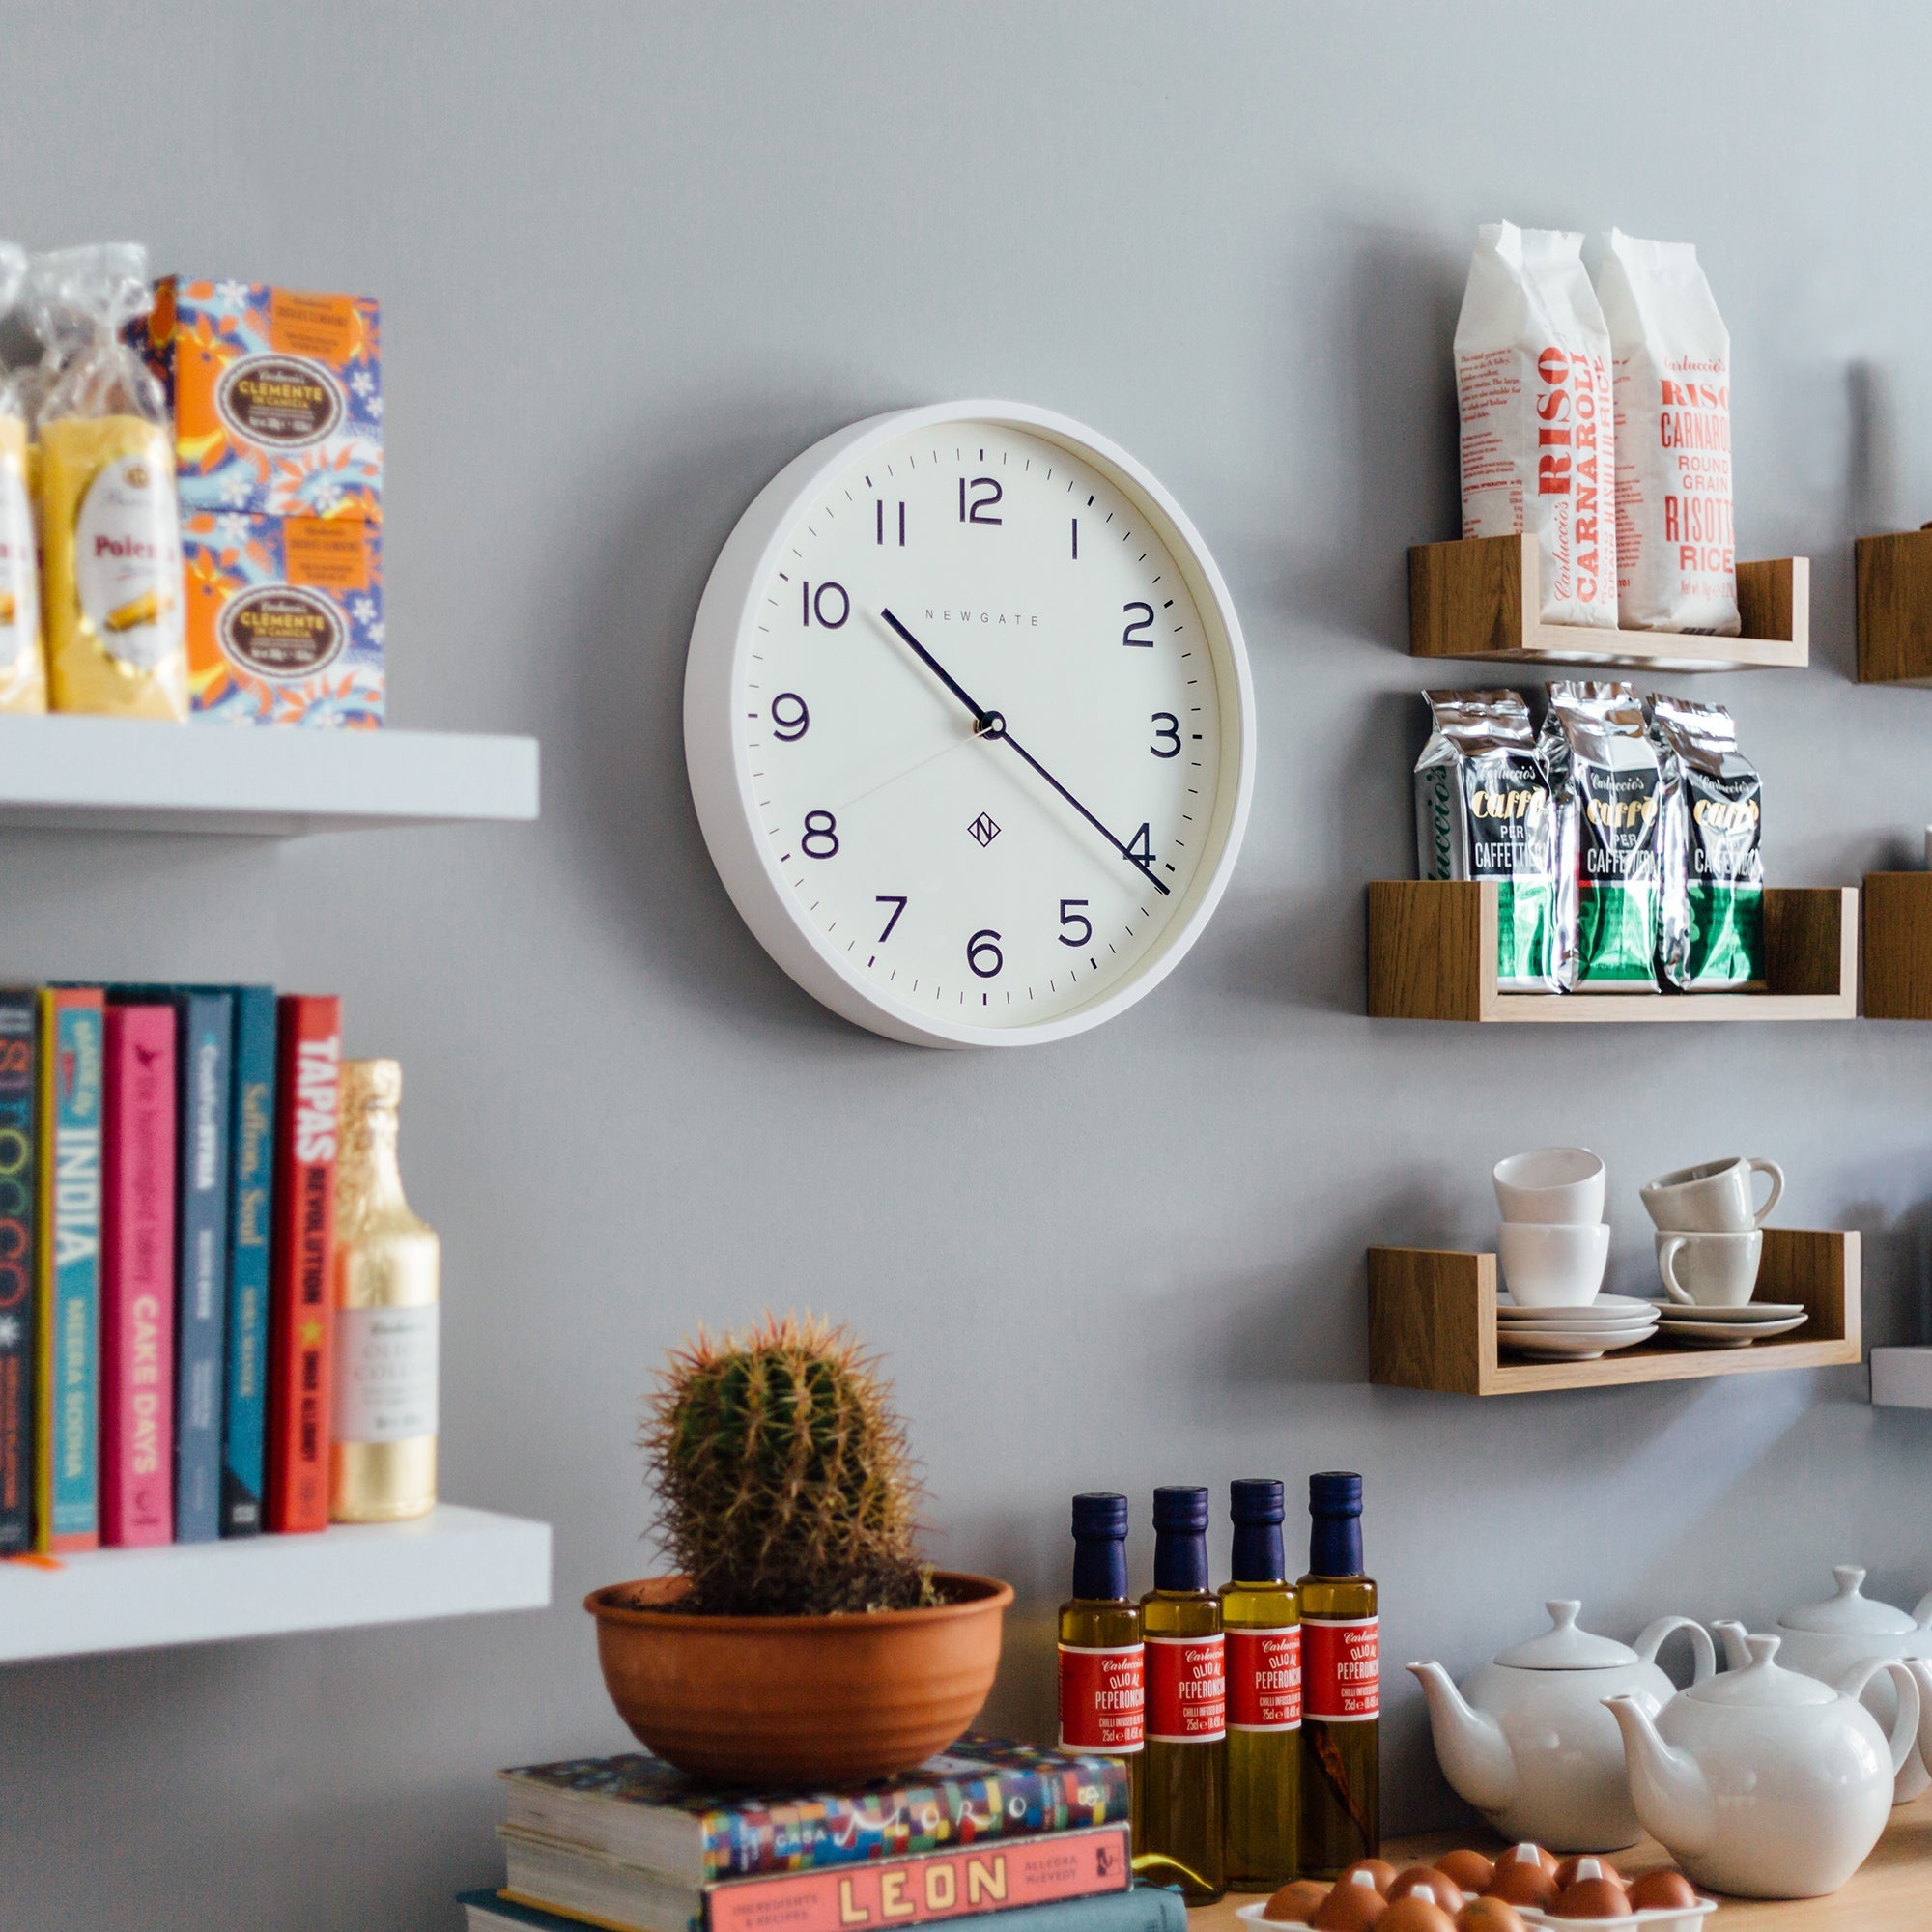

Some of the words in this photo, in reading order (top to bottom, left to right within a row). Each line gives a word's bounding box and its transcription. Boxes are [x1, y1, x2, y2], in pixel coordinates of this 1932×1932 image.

[239, 380, 324, 402] CLEMENTE
[1537, 347, 1572, 497] RISO
[1661, 412, 1731, 454] CARNARO
[1570, 351, 1599, 603] CARNAROLI
[1678, 455, 1729, 474] ROUND
[1682, 474, 1728, 493] GRAIN
[877, 499, 906, 547] 11
[959, 477, 1003, 526] 12
[1071, 518, 1078, 560] 1
[1552, 501, 1570, 602] Carluccio's
[1679, 545, 1734, 574] RICE
[240, 611, 325, 631] CLEMENTE
[802, 581, 851, 629] 10
[925, 609, 1039, 627] NEWGATE
[1122, 601, 1154, 648] 2
[771, 692, 810, 742] 9
[1150, 711, 1181, 758] 3
[801, 810, 839, 860] 8
[1122, 822, 1156, 868] 4
[1427, 765, 1451, 881] uccio's
[1500, 825, 1524, 838] PER
[1614, 833, 1637, 847] PER
[1475, 842, 1536, 867] CAFFETTI
[1587, 848, 1656, 873] CAFFEIERA
[875, 895, 908, 943] 7
[1058, 898, 1093, 948] 5
[966, 929, 1004, 979] 6
[297, 1036, 338, 1162] TAPAS
[56, 1128, 98, 1266] INDIA
[133, 1295, 159, 1387] CAKE
[133, 1393, 158, 1474] DAYS
[1192, 1662, 1212, 1679] OLIO
[1213, 1662, 1221, 1676] AL
[1268, 1653, 1289, 1669] OLIO
[1290, 1654, 1297, 1666] AL
[1337, 1658, 1379, 1680] PEPERONC
[1350, 1644, 1370, 1660] OLIO
[1370, 1644, 1377, 1658] AL
[1095, 1688, 1144, 1710] PEPERONC
[1109, 1672, 1131, 1690] OLIO
[1131, 1673, 1140, 1687] AL
[1179, 1676, 1225, 1699] PEPERONC
[1255, 1666, 1301, 1689] PEPERONC
[775, 1829, 826, 1847] CASA
[833, 1796, 1027, 1847] MORO
[838, 1853, 1007, 1925] LEON
